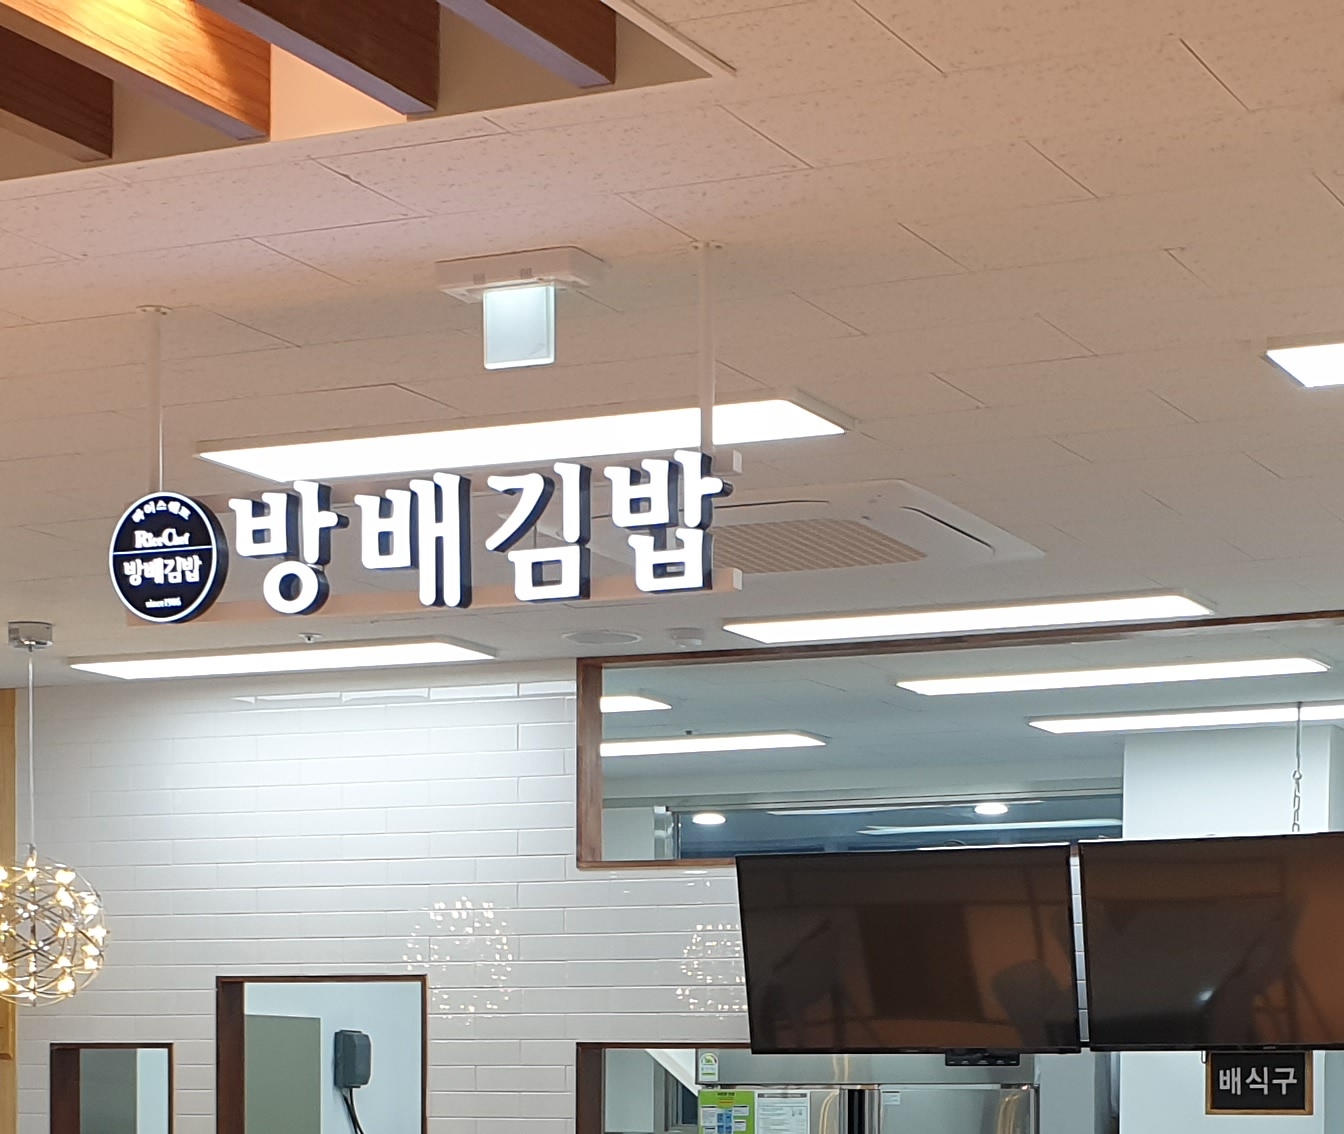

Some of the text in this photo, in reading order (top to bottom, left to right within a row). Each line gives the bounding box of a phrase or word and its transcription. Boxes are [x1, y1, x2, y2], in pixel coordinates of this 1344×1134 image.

[228, 449, 730, 615] 방배김밥
[123, 554, 203, 587] 방배김밥
[1218, 1066, 1298, 1096] 배식구
